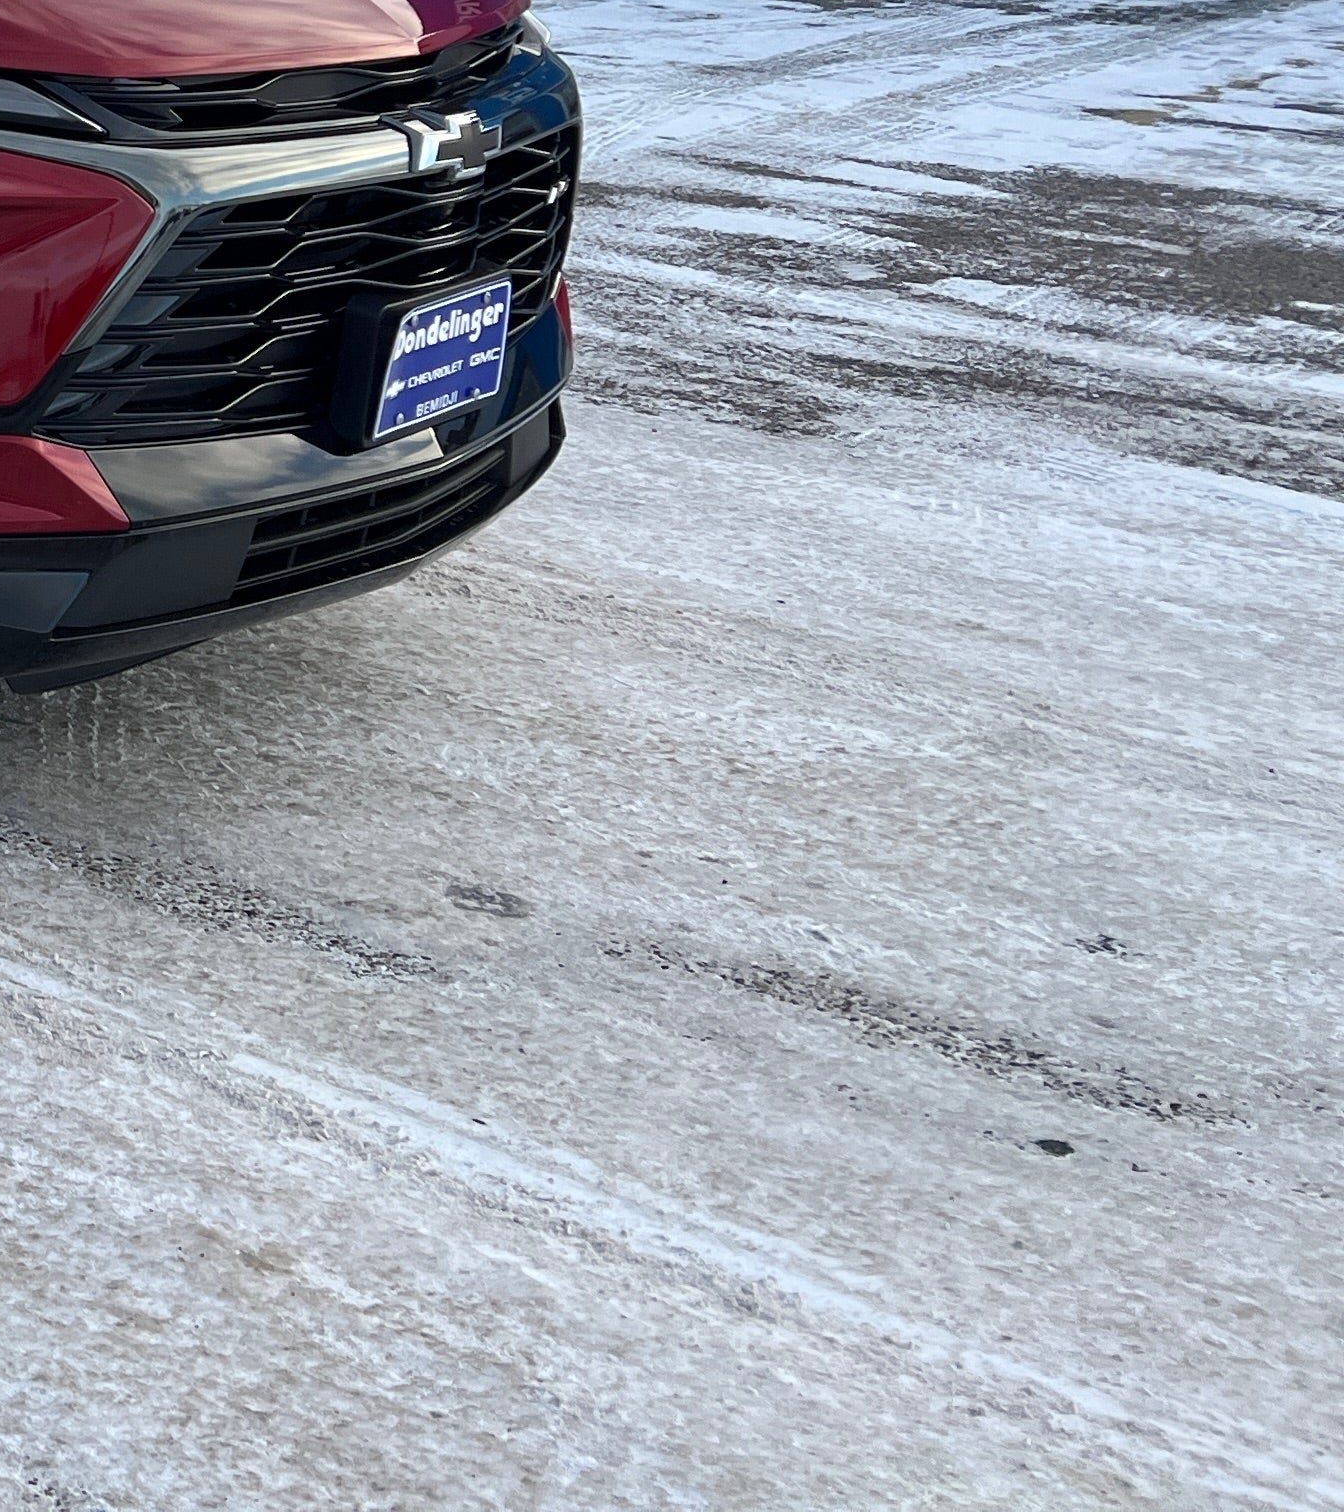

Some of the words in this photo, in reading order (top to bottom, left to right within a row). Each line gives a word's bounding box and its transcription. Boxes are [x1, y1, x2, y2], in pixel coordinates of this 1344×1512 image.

[393, 302, 505, 362] Dondelinger
[407, 359, 465, 389] CHEVROLET
[469, 347, 502, 368] GMC
[416, 390, 460, 418] BEMIDJI
